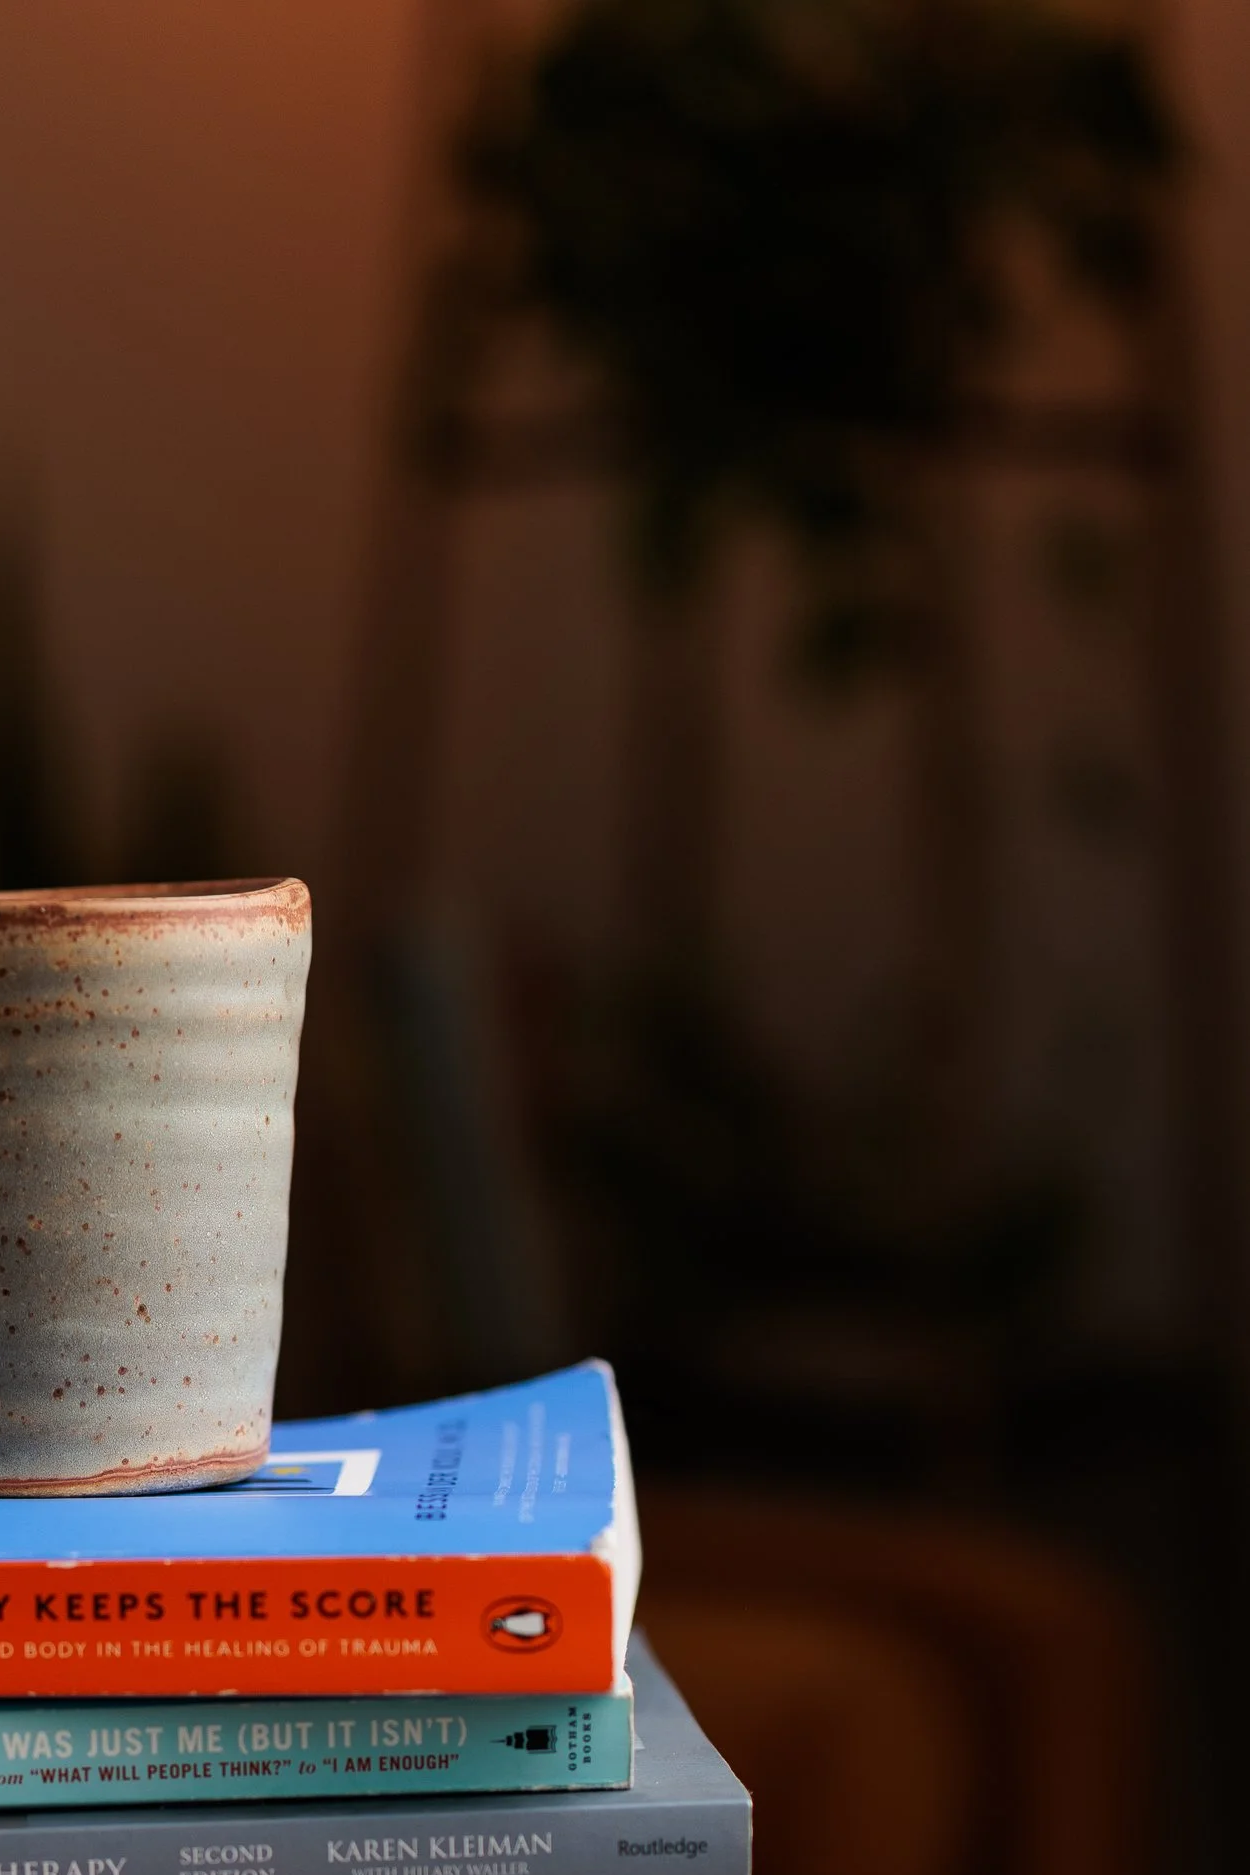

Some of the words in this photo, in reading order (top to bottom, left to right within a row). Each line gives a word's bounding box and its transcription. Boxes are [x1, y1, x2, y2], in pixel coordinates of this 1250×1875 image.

[34, 1592, 165, 1622] KEEPS
[187, 1591, 268, 1621] THE
[290, 1588, 436, 1620] SCORE
[23, 1641, 87, 1659] BODY
[96, 1641, 122, 1658] IN
[130, 1639, 173, 1658] THE
[184, 1638, 291, 1658] HEALING
[298, 1637, 329, 1658] OF
[338, 1637, 439, 1658] TRAUMA
[2, 1729, 73, 1760] WAS
[86, 1725, 164, 1758] JUST
[177, 1724, 223, 1754] ME
[237, 1721, 313, 1752] (BUT
[327, 1720, 356, 1748] IT
[370, 1715, 467, 1747] ISN'T)
[582, 1712, 592, 1764] BOOKS
[29, 1766, 91, 1784] "WHAT
[98, 1765, 140, 1782] WILL
[148, 1762, 212, 1780] PEOPLE
[220, 1759, 292, 1777] THINK?"
[298, 1760, 316, 1775] to
[322, 1758, 339, 1774] "I
[345, 1757, 372, 1772] AM
[379, 1753, 459, 1772] ENOUGH"
[179, 1844, 274, 1866] SECOND
[326, 1837, 419, 1863] KAREN
[429, 1832, 553, 1861] KLEIMAN
[617, 1836, 708, 1860] Routledge
